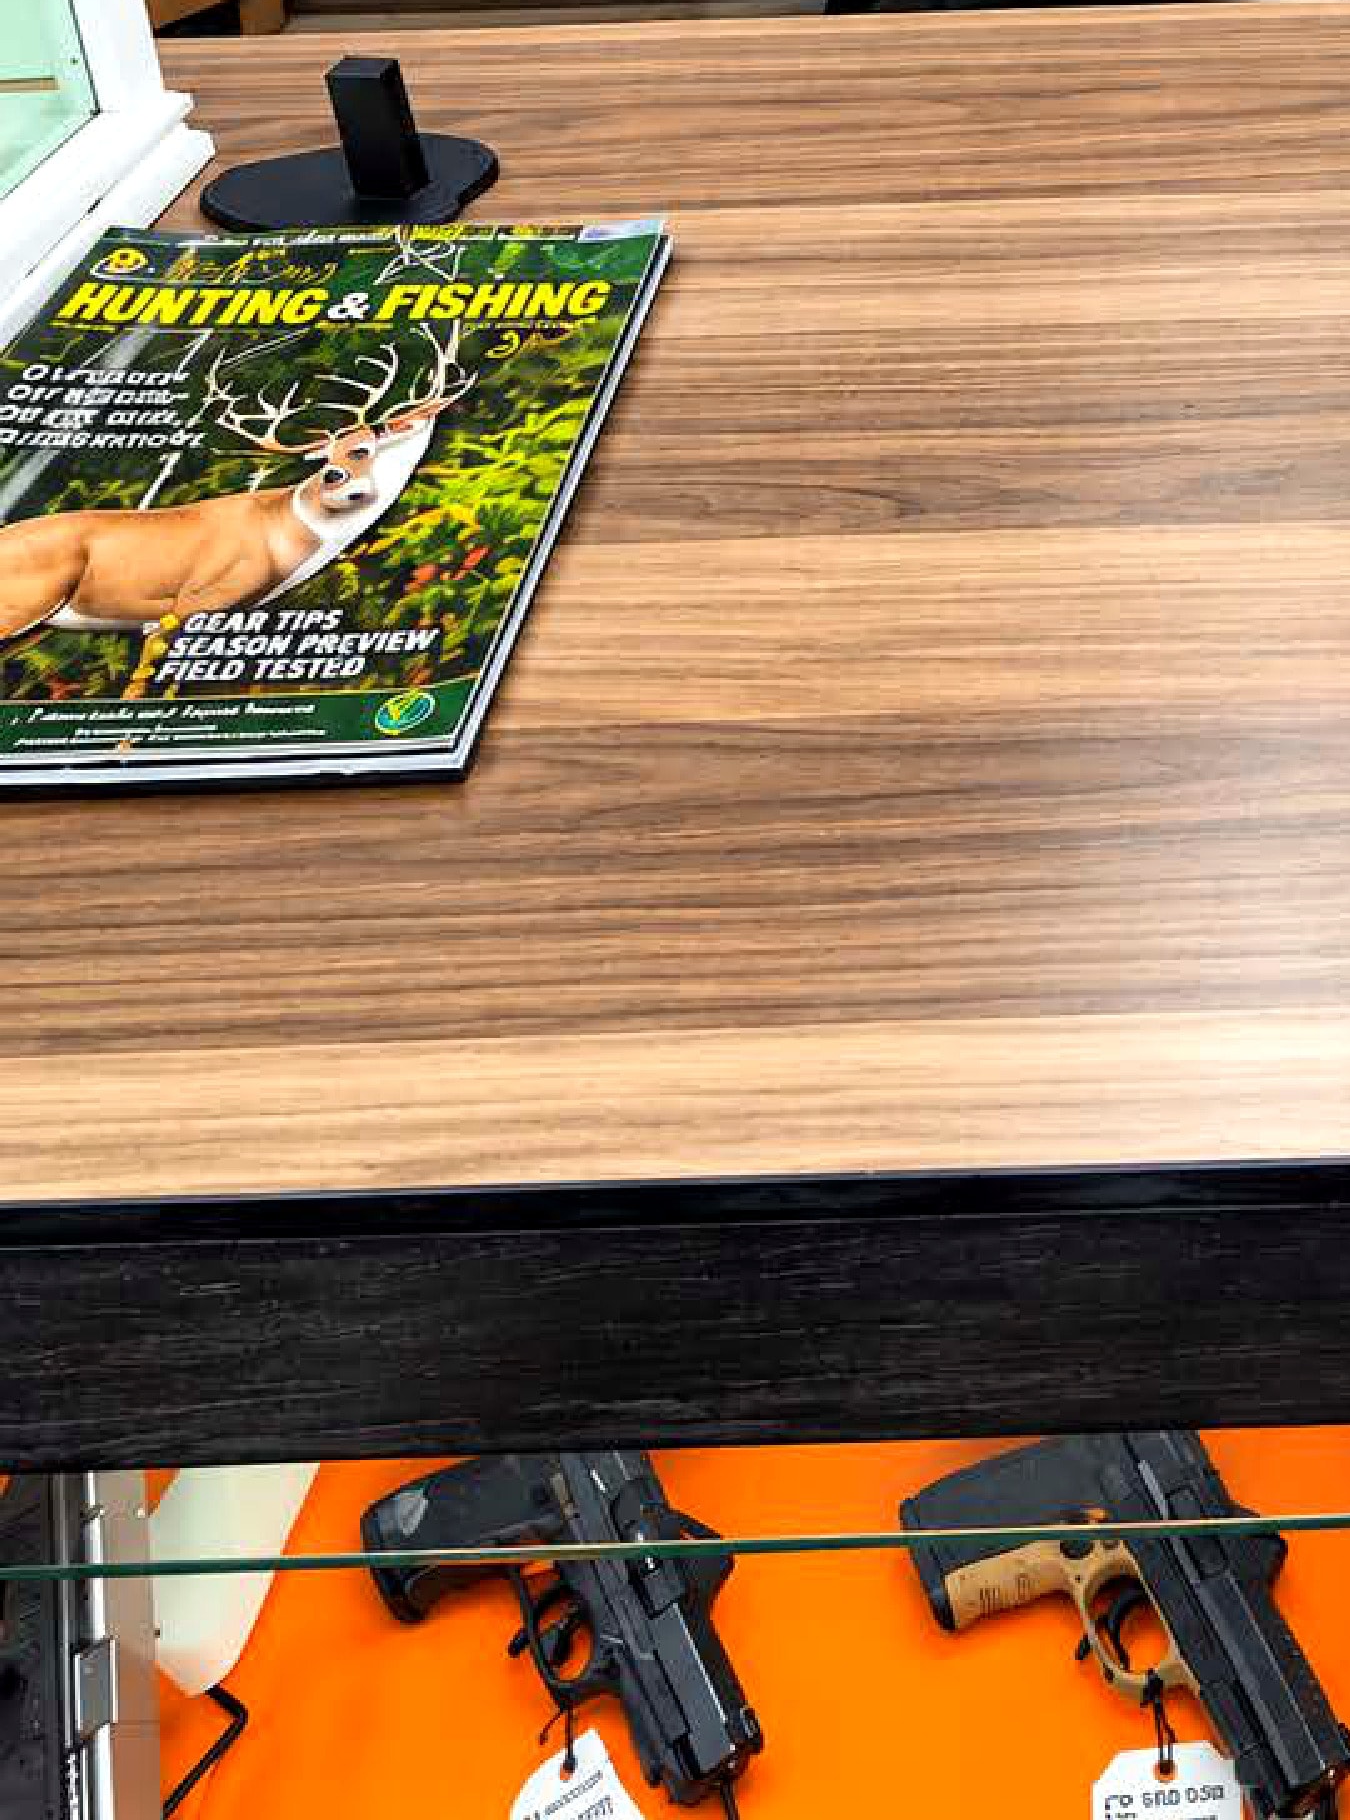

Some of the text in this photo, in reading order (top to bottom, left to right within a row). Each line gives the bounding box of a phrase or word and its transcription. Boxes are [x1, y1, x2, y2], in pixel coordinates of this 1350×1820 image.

[57, 281, 611, 325] HUNTING & FISHING
[184, 609, 344, 633] GEAR TIPS
[167, 629, 439, 658] SEASON PREVIEW
[155, 657, 366, 682] FIELD TESTED
